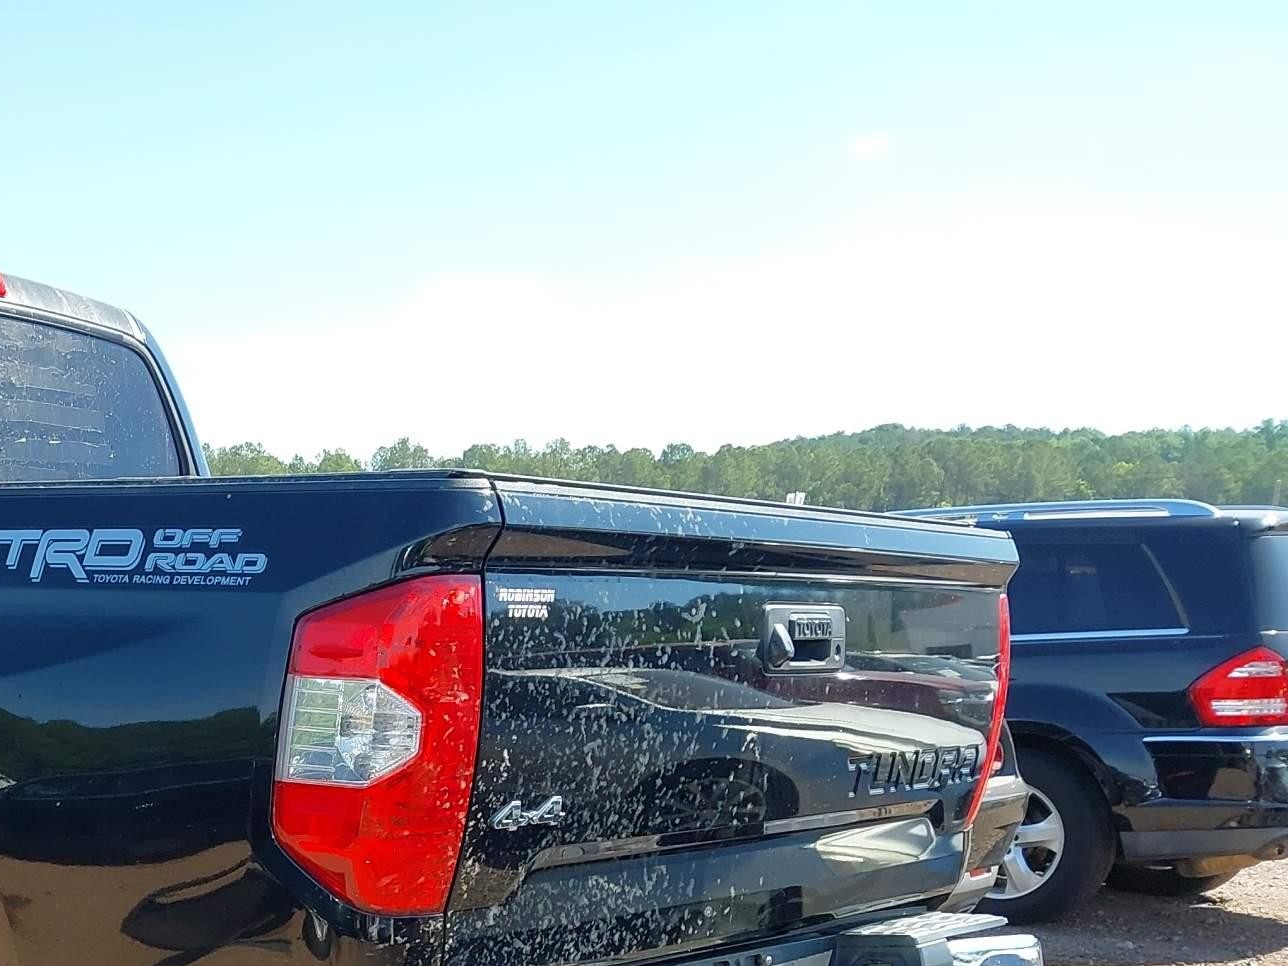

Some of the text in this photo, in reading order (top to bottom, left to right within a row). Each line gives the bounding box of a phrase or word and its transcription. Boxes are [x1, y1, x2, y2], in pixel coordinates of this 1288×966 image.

[153, 528, 242, 548] OFF
[145, 553, 267, 573] ROAD
[93, 574, 251, 586] TOYOTA RACING DEVELOPMENT
[507, 604, 549, 618] TOYOTA
[796, 618, 832, 637] TOYOTA
[848, 745, 980, 798] TUNDRA
